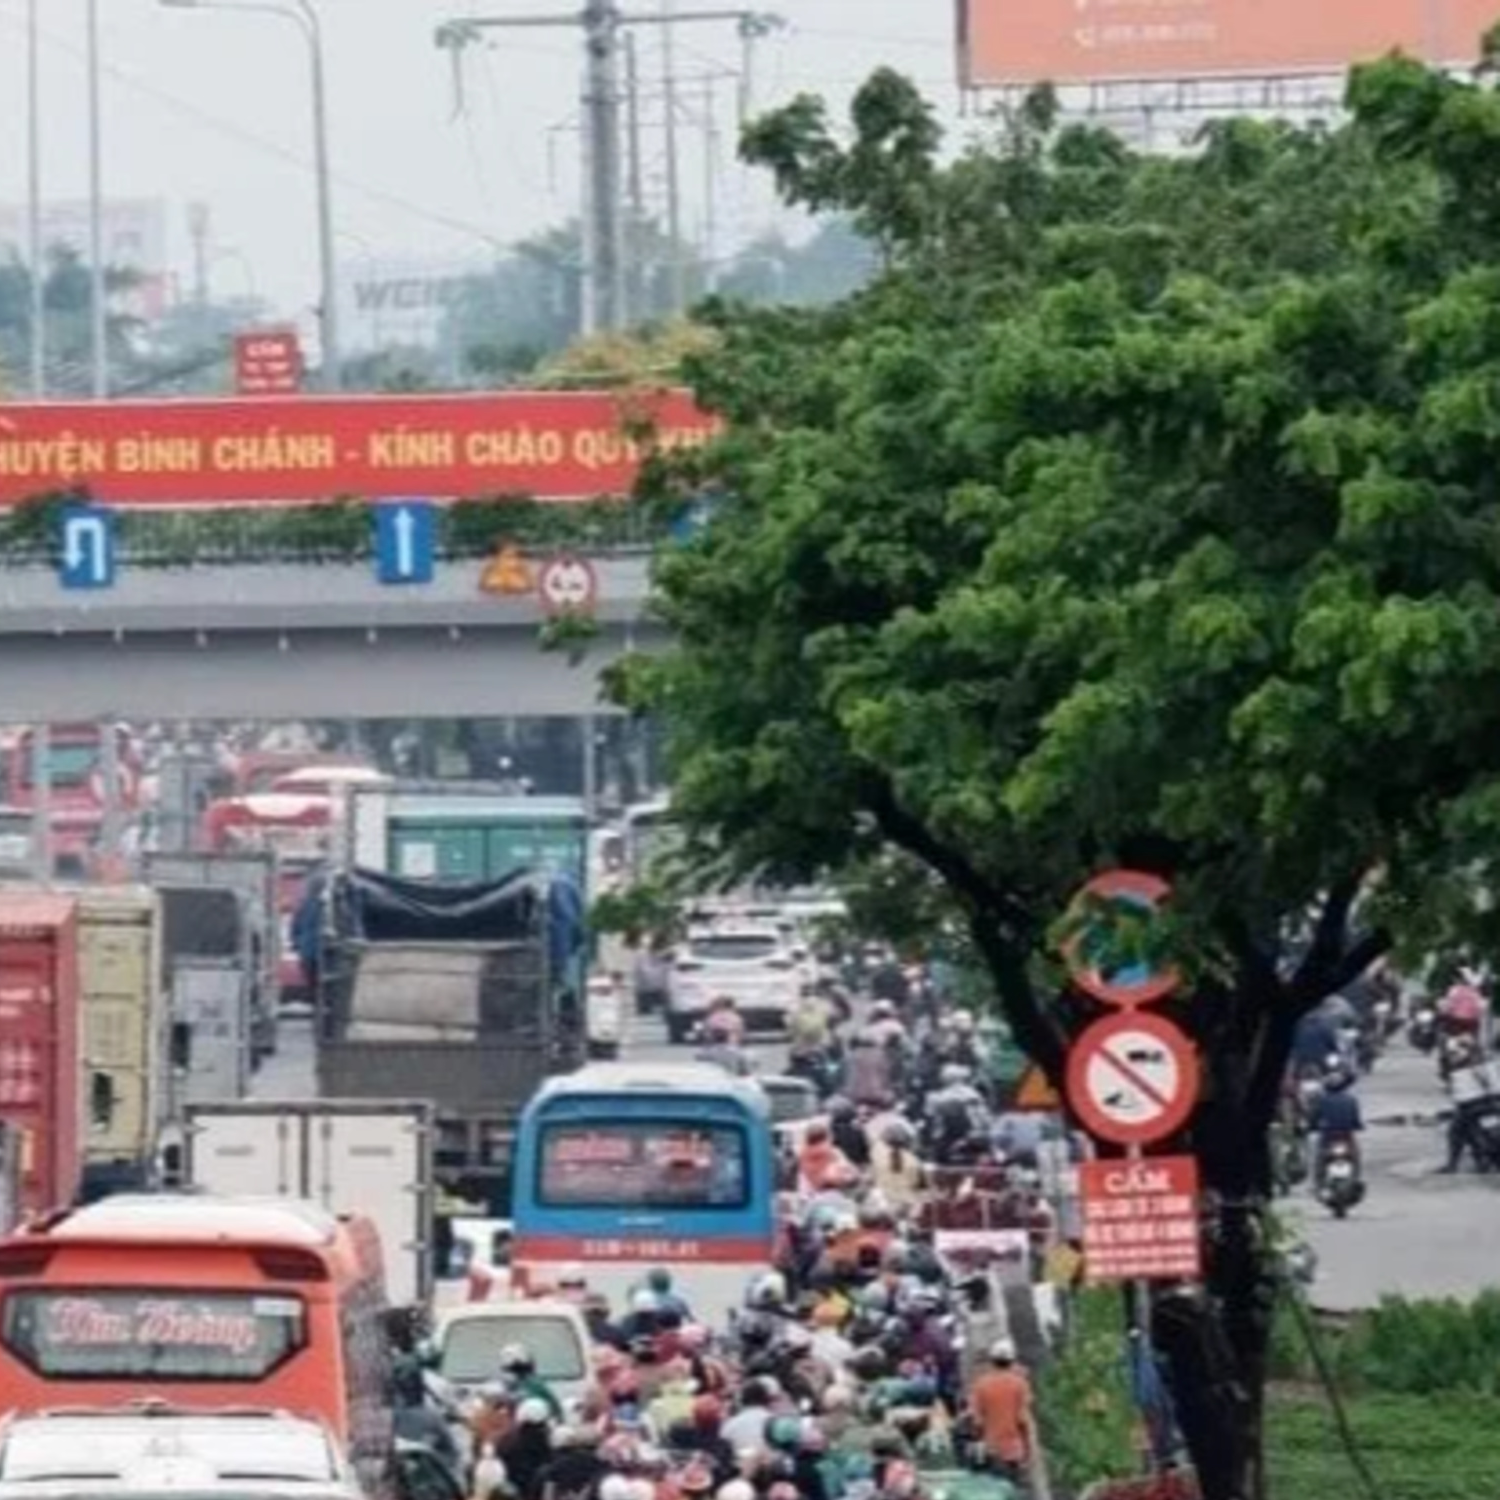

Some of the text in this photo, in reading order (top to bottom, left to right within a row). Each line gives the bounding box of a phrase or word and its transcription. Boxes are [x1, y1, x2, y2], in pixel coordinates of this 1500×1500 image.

[115, 430, 200, 472] BÌNH
[213, 427, 334, 470] CHÁNH
[368, 423, 454, 468] KÍNH
[466, 422, 560, 466] CHÀO
[1103, 1163, 1172, 1194] CẤM
